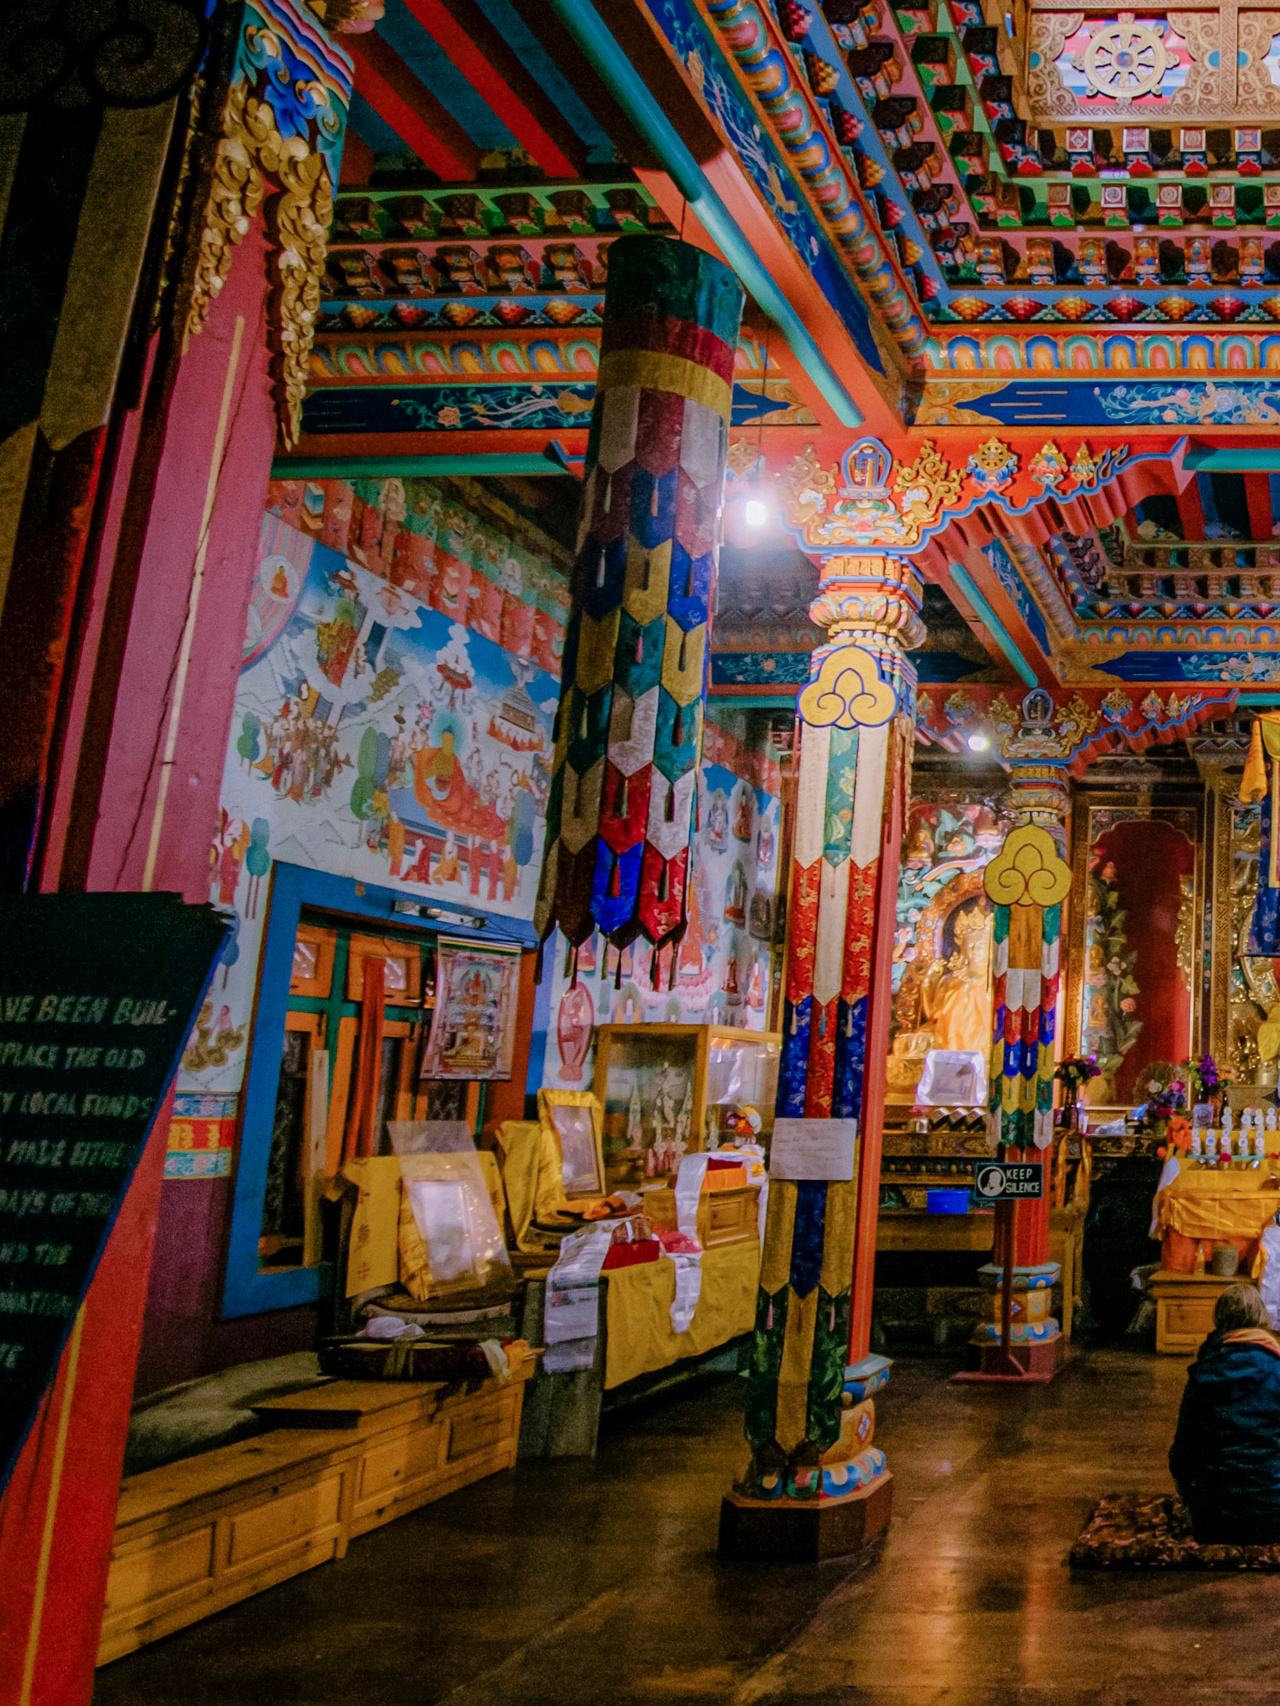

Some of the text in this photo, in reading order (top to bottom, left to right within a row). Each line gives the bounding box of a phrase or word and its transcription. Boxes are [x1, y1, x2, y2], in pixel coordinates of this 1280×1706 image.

[0, 995, 34, 1022] VE
[36, 995, 110, 1023] BEEN
[0, 1042, 146, 1069] PLACE THE OLD
[20, 1091, 76, 1115] LOCAL
[1006, 1168, 1033, 1180] KEEP
[1005, 1181, 1040, 1193] SILENCE
[35, 1243, 72, 1265] THE
